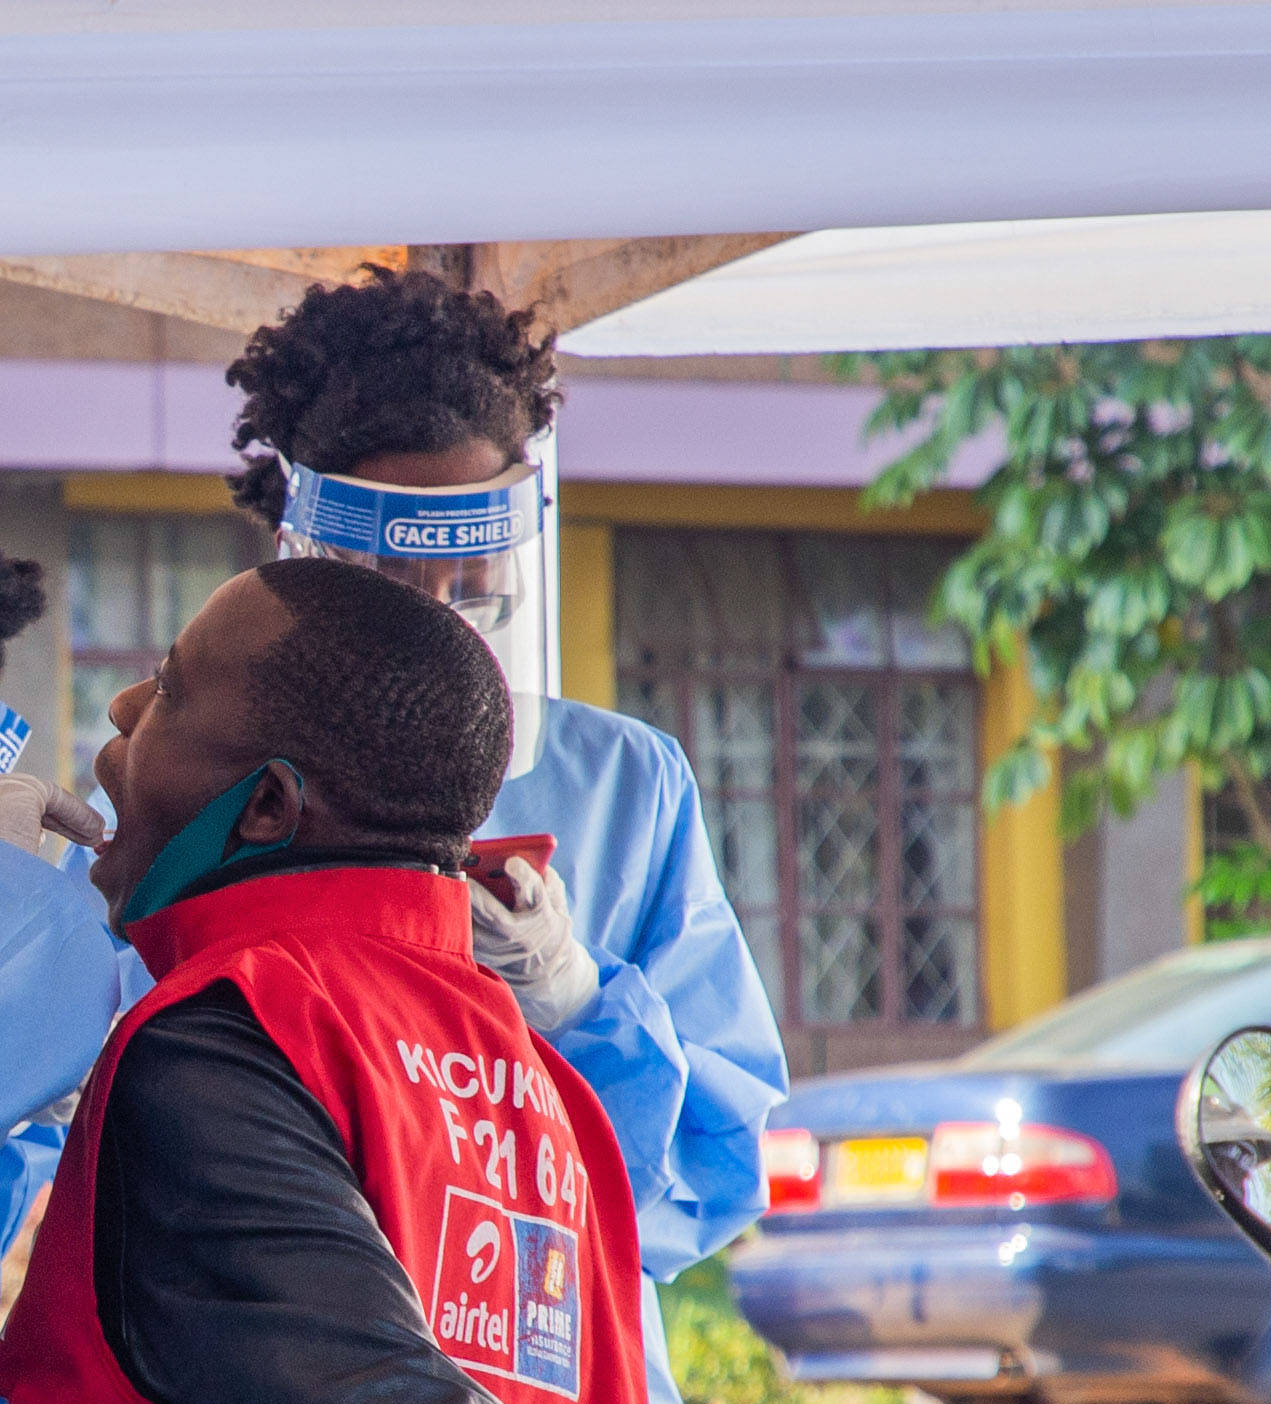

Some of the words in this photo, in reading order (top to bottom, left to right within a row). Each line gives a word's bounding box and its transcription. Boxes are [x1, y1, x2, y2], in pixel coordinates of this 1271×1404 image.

[393, 525, 450, 546] FACE
[455, 519, 521, 545] SHIELD
[396, 1039, 571, 1133] KICUKIR
[440, 1291, 509, 1355] airtel
